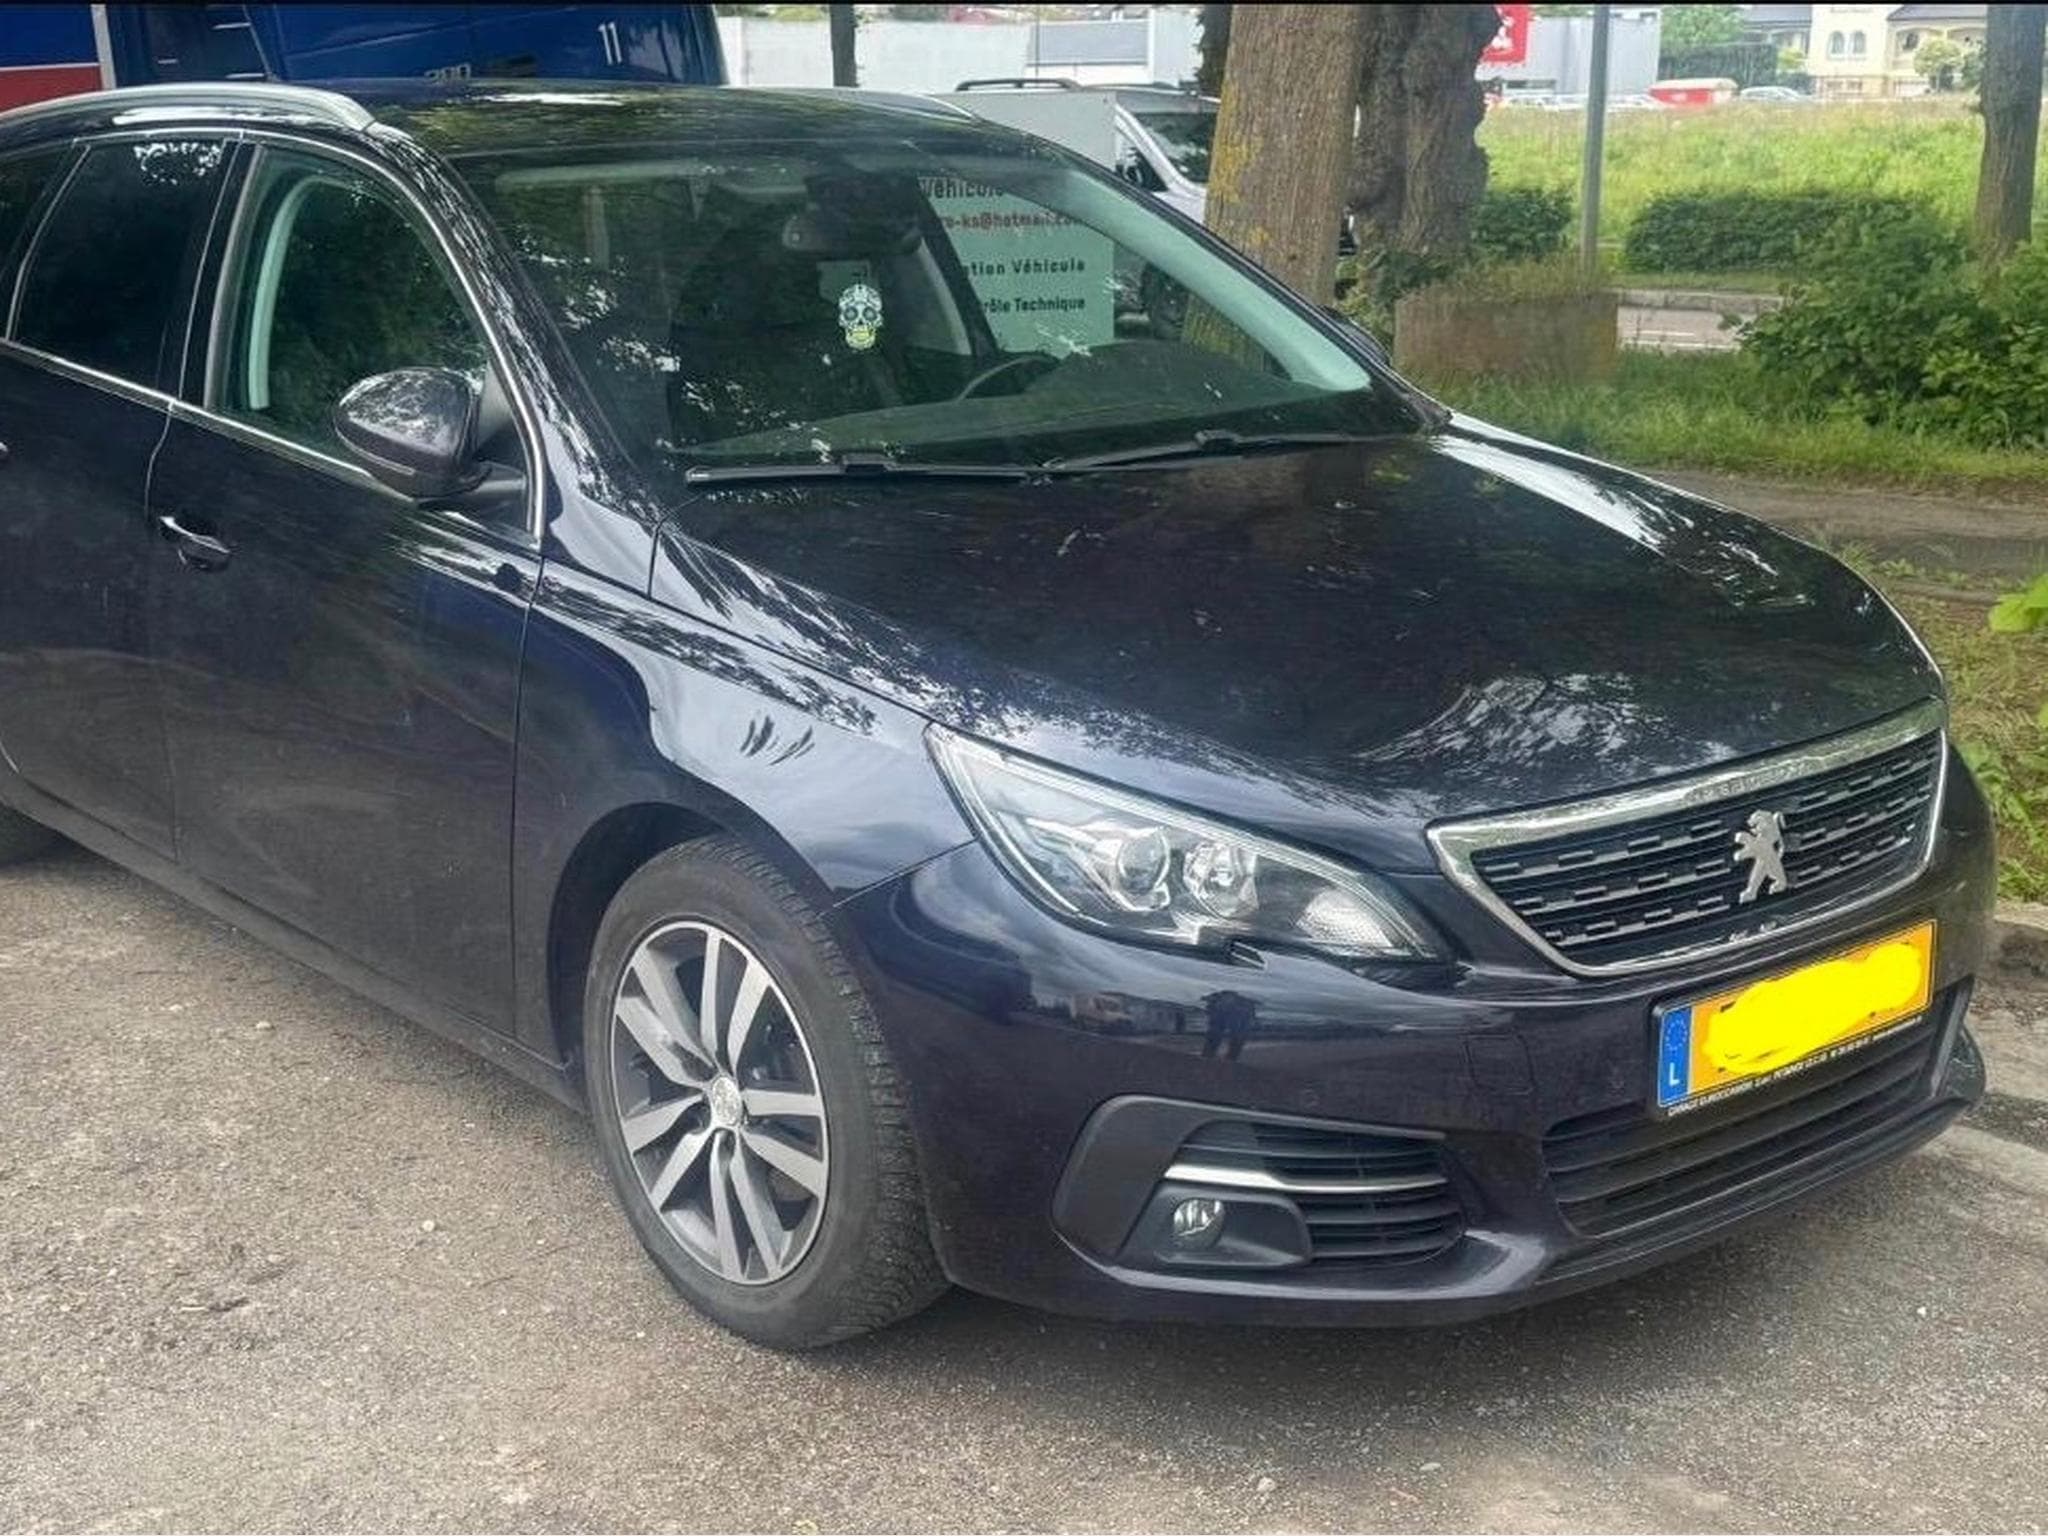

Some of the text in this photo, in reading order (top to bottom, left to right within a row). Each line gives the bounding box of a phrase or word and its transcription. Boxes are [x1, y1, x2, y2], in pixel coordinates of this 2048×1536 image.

[598, 22, 622, 65] 11
[1010, 257, 1085, 273] Véhicule
[1013, 297, 1085, 313] Technique
[1669, 1062, 1680, 1087] L
